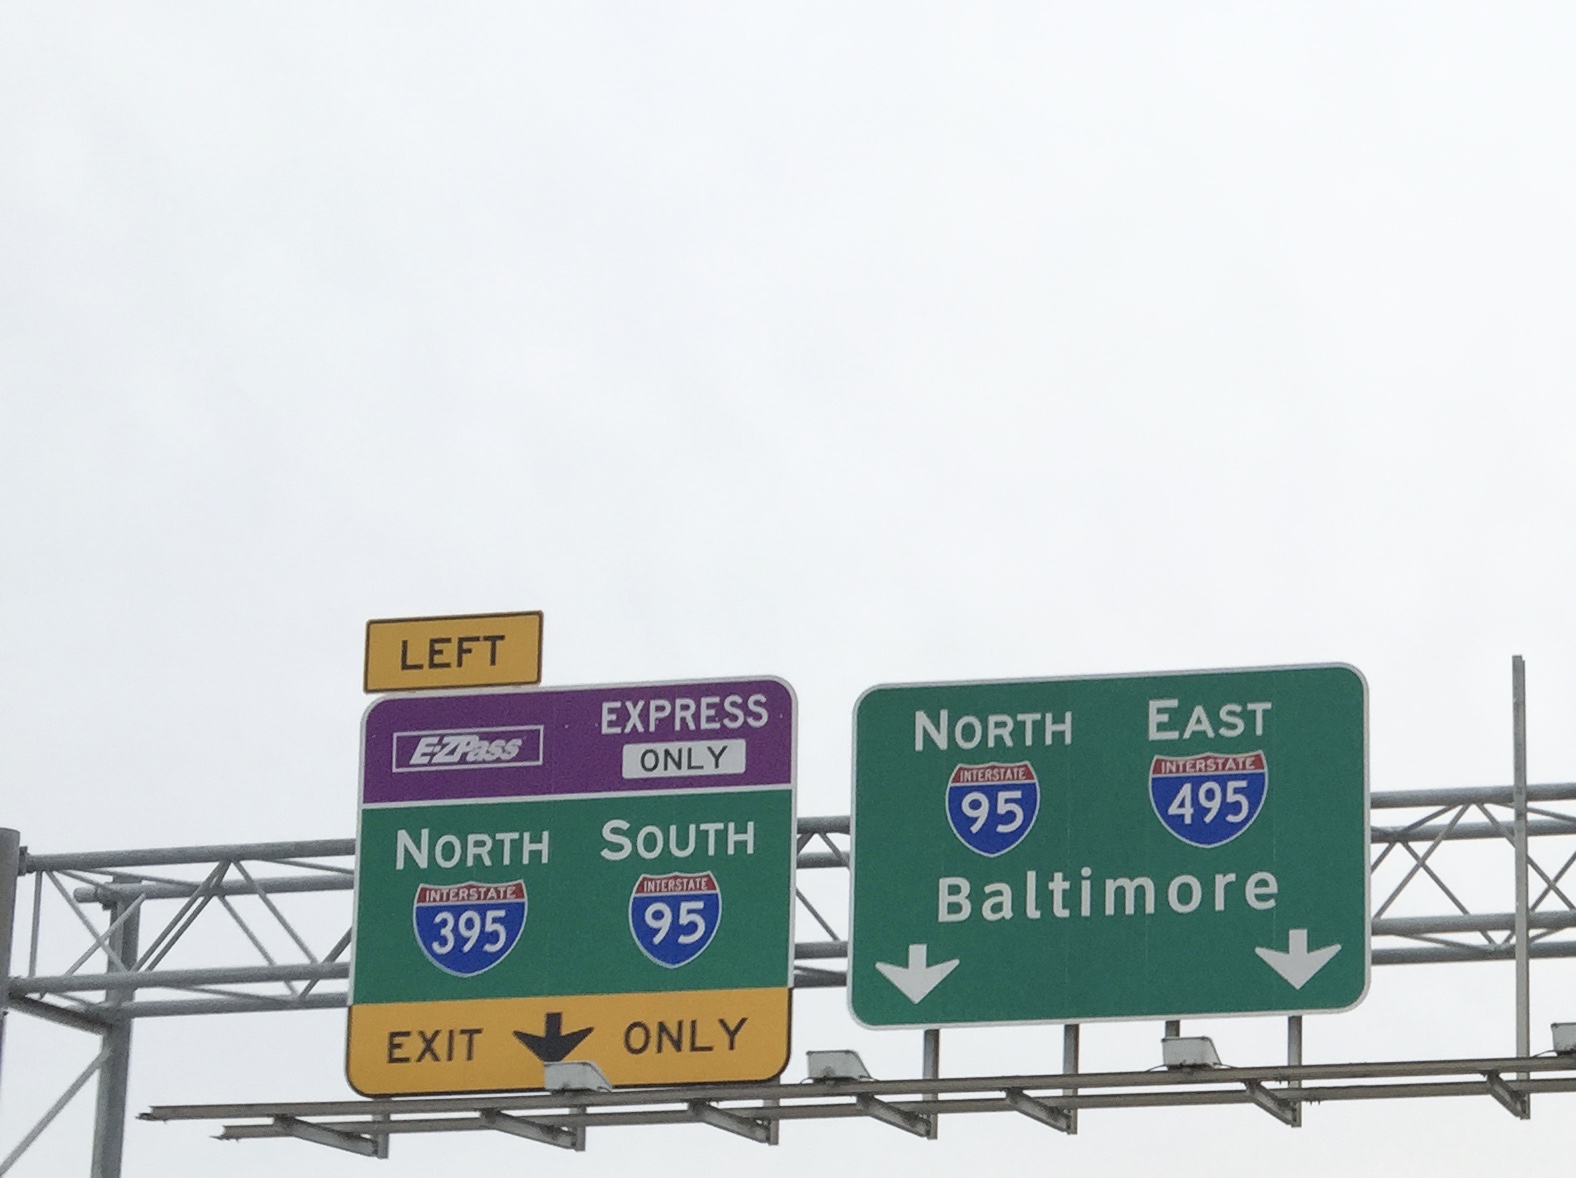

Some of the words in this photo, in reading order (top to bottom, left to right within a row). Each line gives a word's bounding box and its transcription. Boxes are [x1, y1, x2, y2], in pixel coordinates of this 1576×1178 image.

[400, 635, 505, 670] LEFT
[601, 695, 769, 734] EXPRESS
[640, 746, 728, 772] ONLY
[960, 767, 1026, 782] INTERSTATE
[1161, 757, 1256, 773] INTERSTATE
[961, 790, 1024, 834] 95
[1168, 780, 1249, 825] 495
[425, 886, 516, 902] INTERSTATE
[644, 878, 709, 893] INTERSTATE
[938, 867, 1279, 923] Baltimore
[432, 910, 507, 955] 395
[645, 901, 706, 945] 95
[387, 1028, 484, 1064] EXIT
[623, 1018, 748, 1055] ONLY
